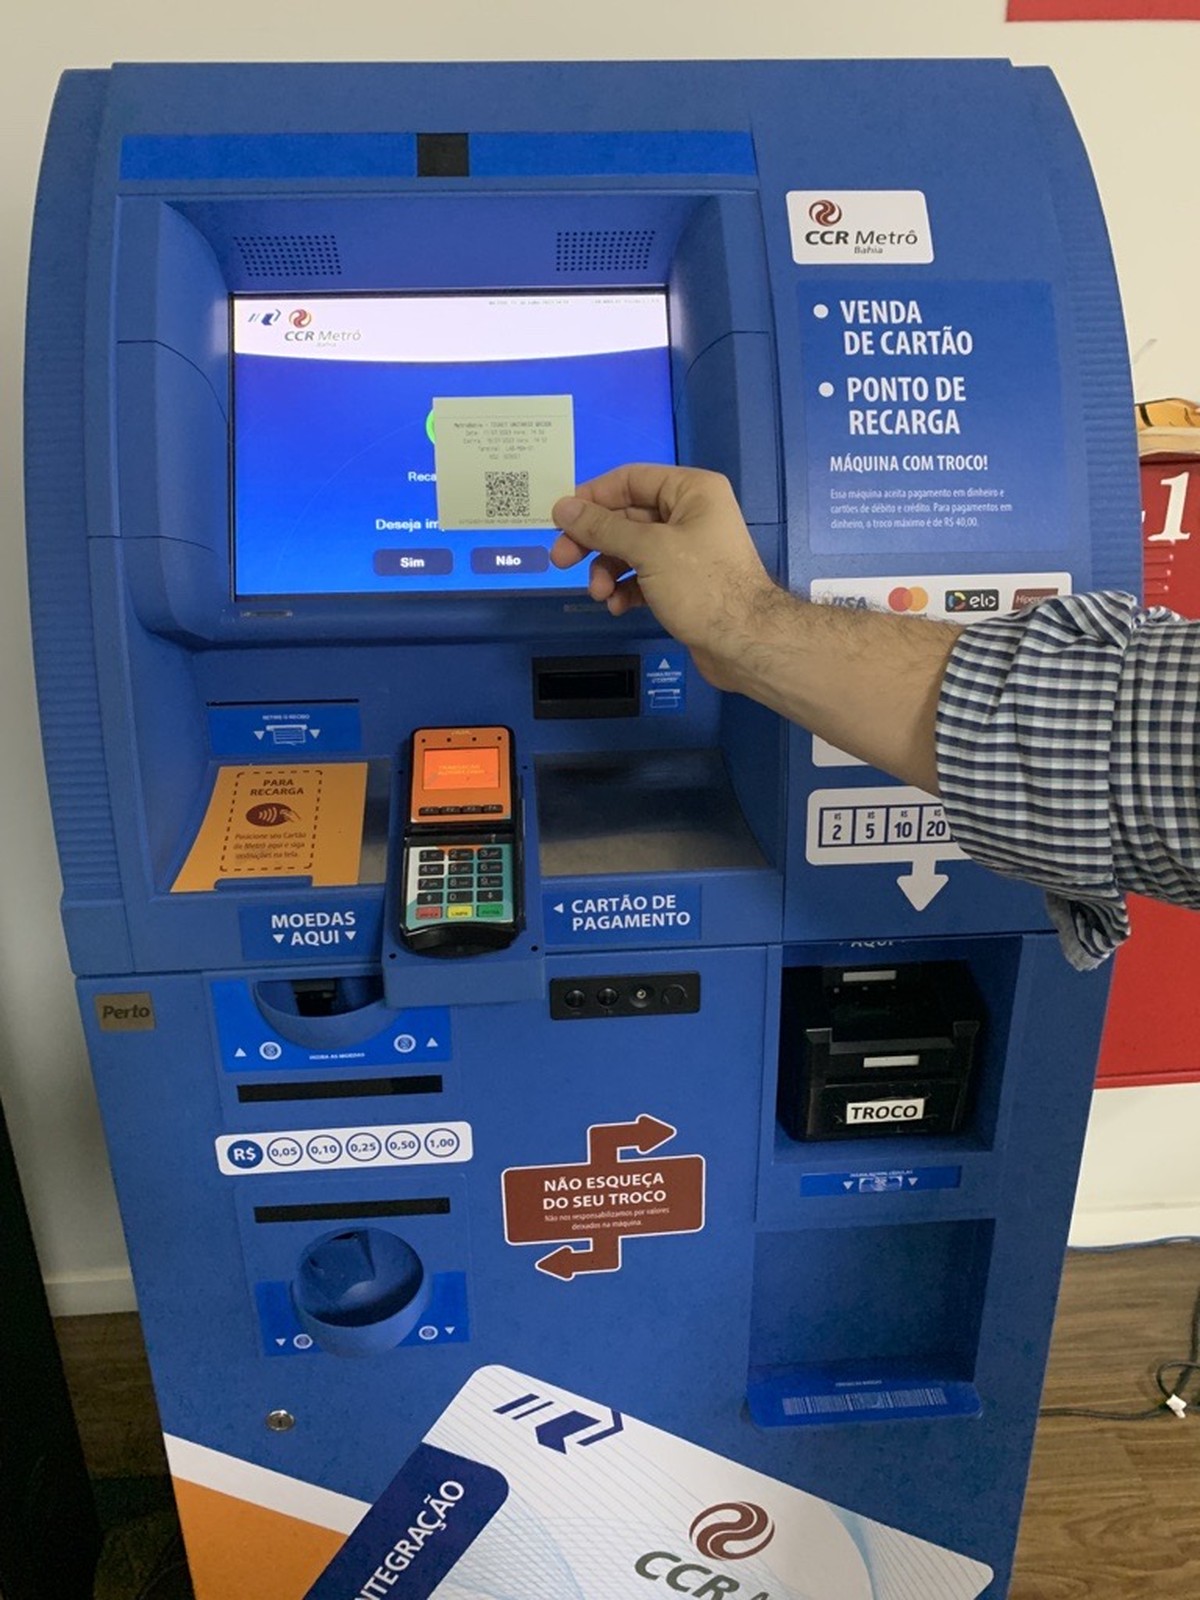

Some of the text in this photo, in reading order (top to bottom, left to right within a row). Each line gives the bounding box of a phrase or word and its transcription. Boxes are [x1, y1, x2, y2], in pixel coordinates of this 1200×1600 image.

[805, 229, 918, 245] CCR Metrô
[854, 246, 883, 254] Bahia
[839, 300, 922, 324] VENDA
[284, 330, 315, 341] CCR
[843, 325, 973, 356] DE CARTÃO
[847, 376, 966, 402] PONTO DE
[849, 409, 961, 435] RECARGA
[830, 452, 988, 473] MÁQUINA COM TROCO!
[408, 471, 437, 482] Reca
[830, 487, 1005, 500] Essa máquina aceita pagamento em dinheiro e
[830, 504, 858, 514] cartões
[860, 503, 870, 513] de
[871, 503, 896, 513] débito
[897, 505, 902, 513] e
[933, 502, 950, 512] Para
[951, 503, 999, 514] pagamentos
[1000, 504, 1013, 512] em
[1141, 472, 1191, 542] 1
[375, 518, 421, 532] Deseja
[425, 518, 445, 532] im
[865, 520, 872, 528] o
[872, 519, 893, 528] troco
[893, 518, 925, 528] máximo
[932, 517, 943, 527] de
[400, 556, 425, 568] Sim
[495, 555, 521, 566] Não
[969, 593, 997, 608] elo
[250, 787, 304, 796] RECARGA
[832, 820, 946, 840] 2 5 10 20
[451, 850, 457, 858] 2
[571, 894, 676, 914] CARTÃO DE
[271, 911, 355, 928] MOEDAS
[572, 912, 691, 931] PAGAMENTO
[291, 930, 339, 946] AQUI
[102, 1004, 150, 1019] Perto
[851, 1105, 918, 1120] TROCO
[233, 1138, 454, 1162] R$ 0,05 0,10 0,25 0,50 1,00
[544, 1172, 664, 1192] NÃO ESQUEÇA
[543, 1190, 667, 1210] DO SEU TROCO
[544, 1214, 558, 1222] Não
[634, 1209, 645, 1217] por
[634, 1551, 740, 1600] CCR
